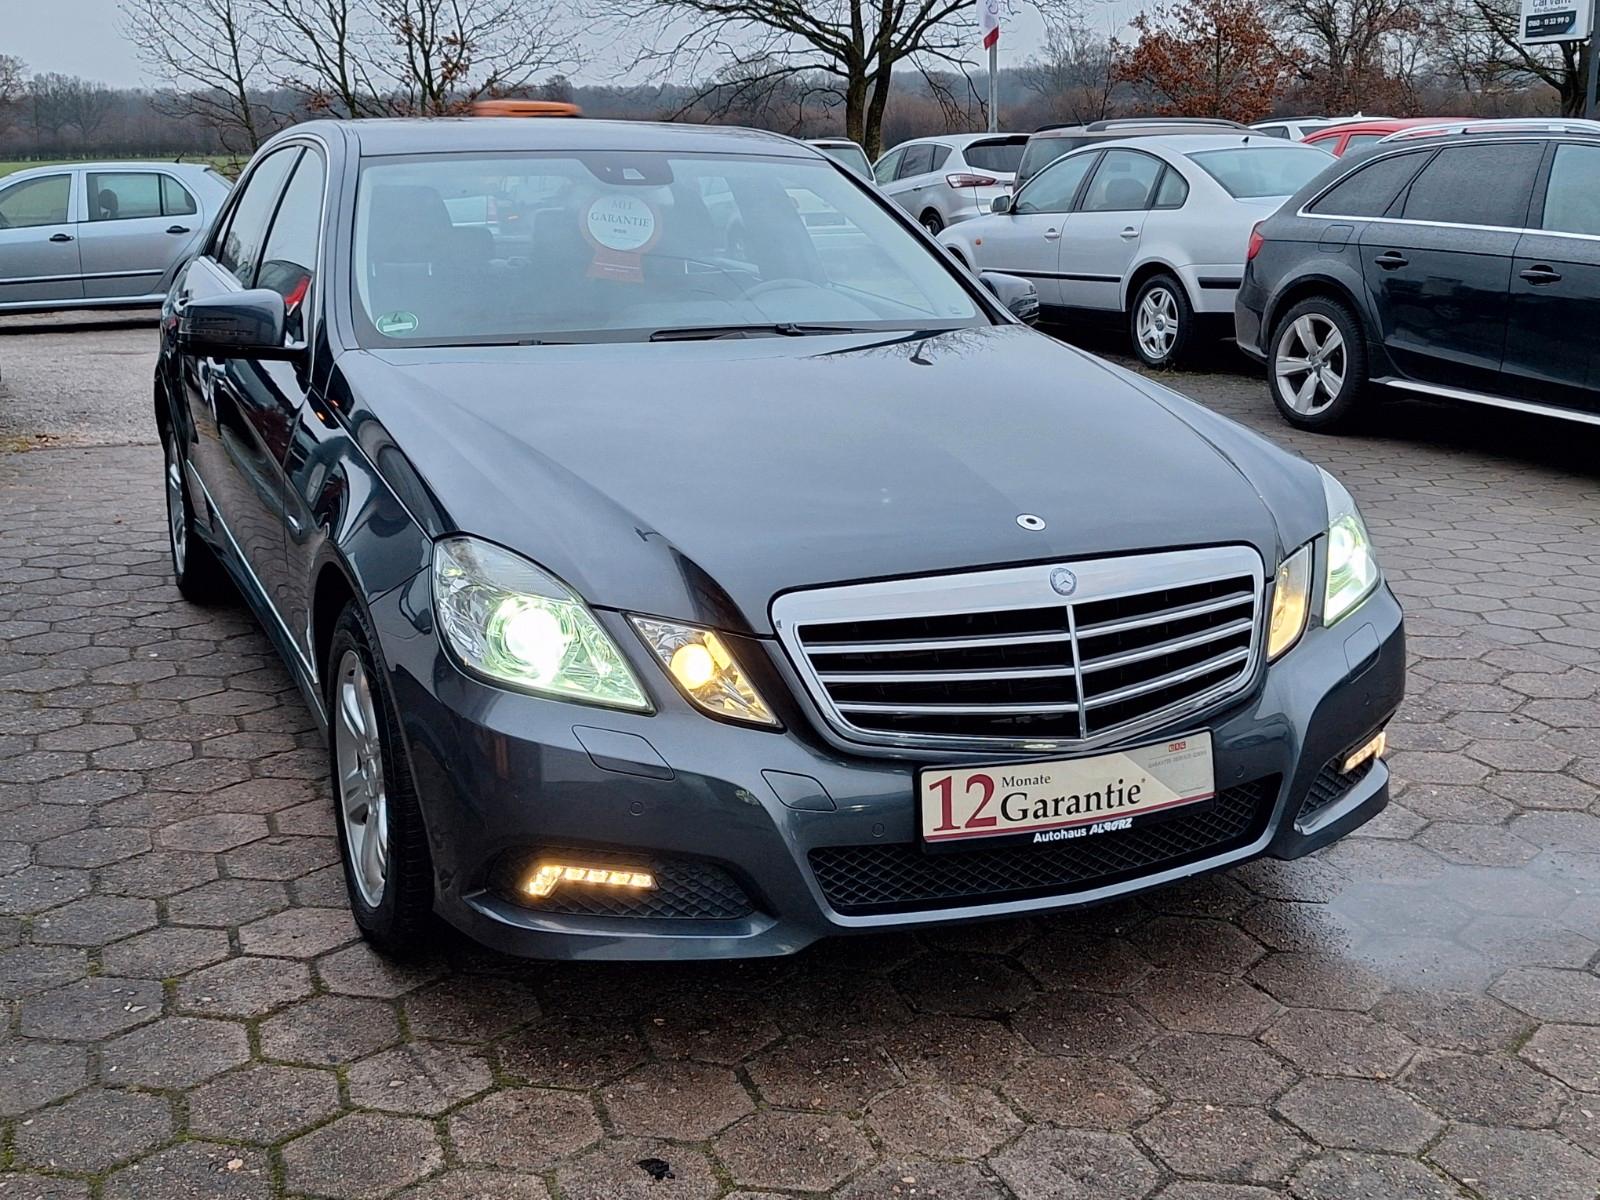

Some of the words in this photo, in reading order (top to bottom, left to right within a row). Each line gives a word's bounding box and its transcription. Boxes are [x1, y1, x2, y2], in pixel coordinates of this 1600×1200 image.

[591, 212, 649, 228] GARANTIE
[929, 773, 997, 832] 12
[1001, 774, 1051, 788] Monate
[1000, 777, 1143, 822] Garantie
[1033, 828, 1087, 844] Autohaus
